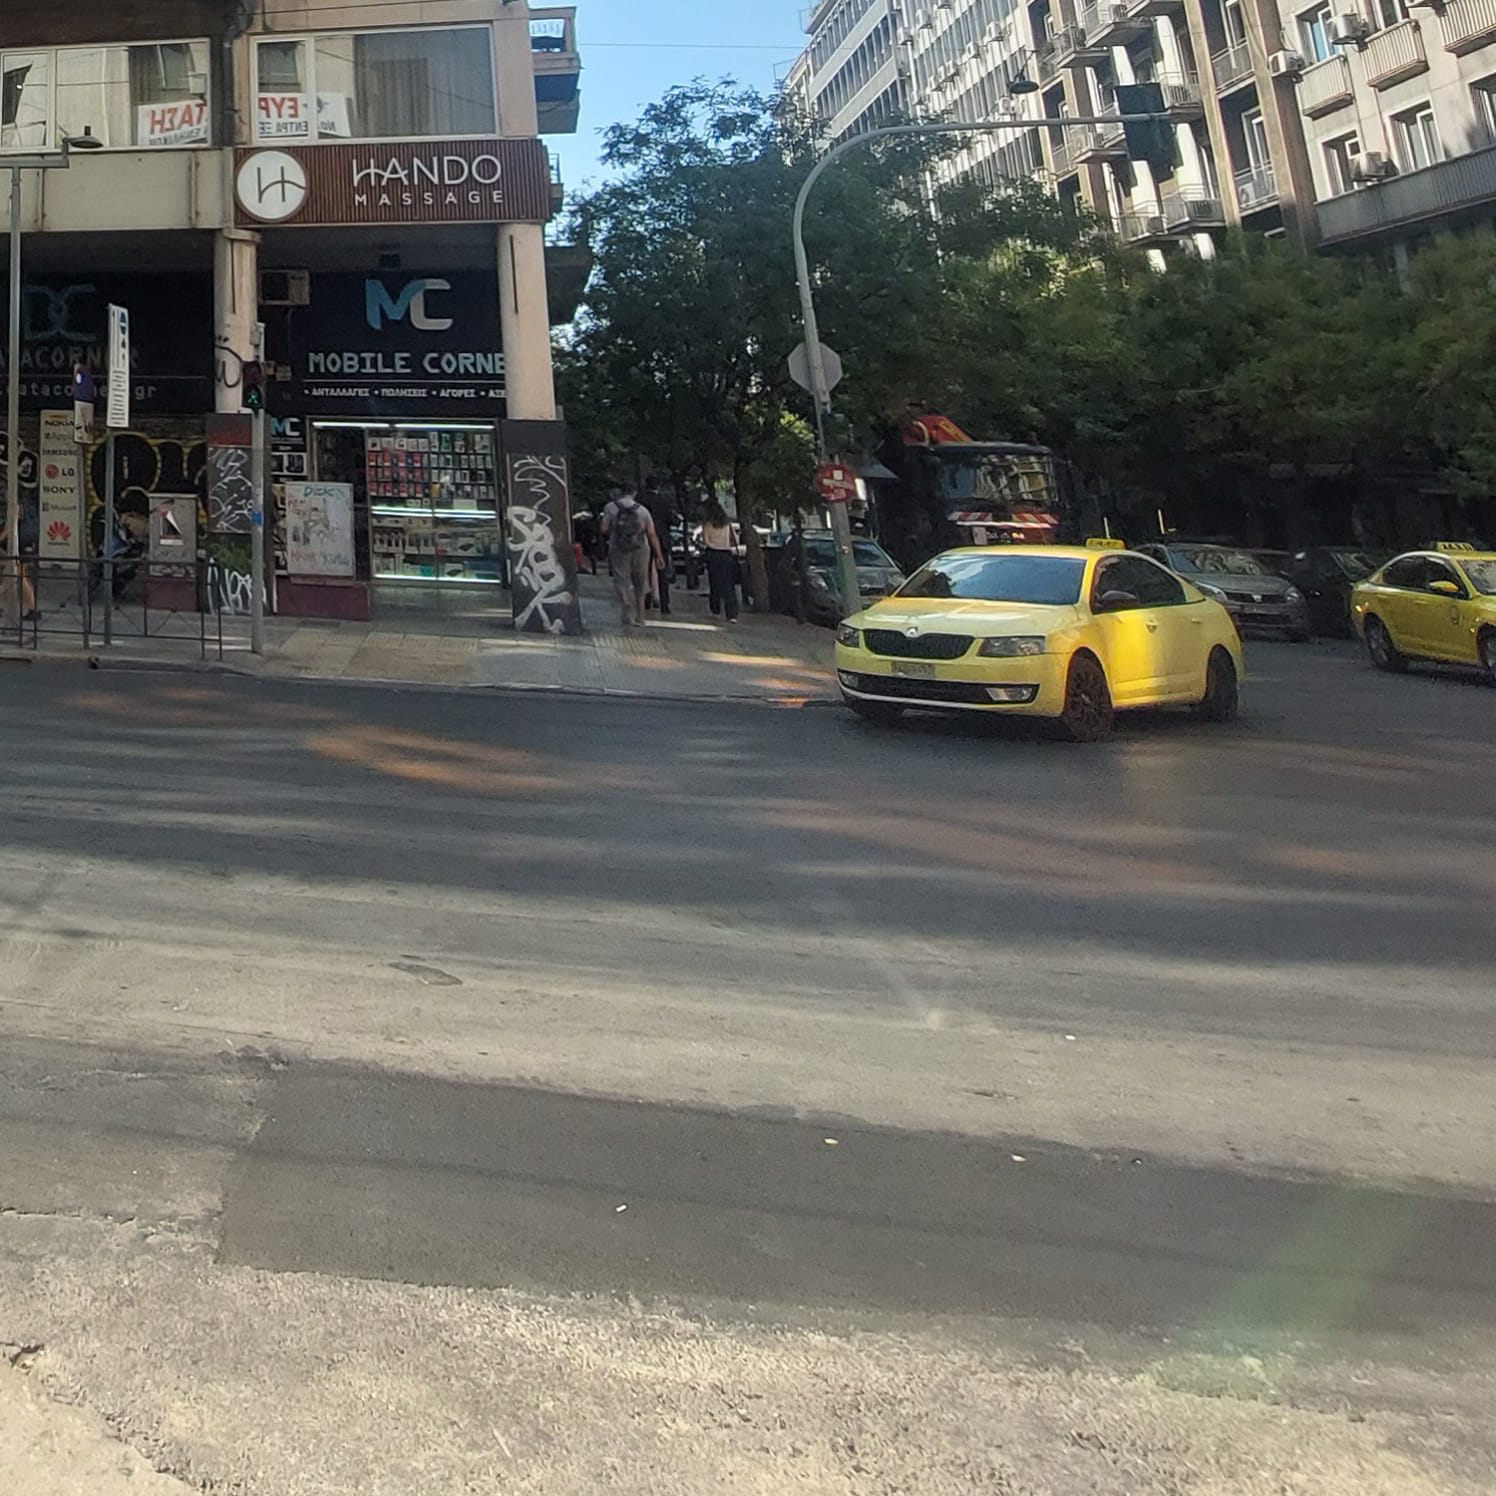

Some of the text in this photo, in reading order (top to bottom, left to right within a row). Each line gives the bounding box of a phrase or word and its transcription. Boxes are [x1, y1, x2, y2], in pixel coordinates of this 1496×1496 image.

[352, 154, 502, 187] HANDO
[354, 190, 504, 207] MASSAGE
[364, 277, 453, 331] MC
[308, 352, 413, 374] MOBILE
[439, 388, 476, 398] ΑΓΟΡΕΣ
[61, 467, 76, 477] LG
[42, 486, 76, 494] SONY
